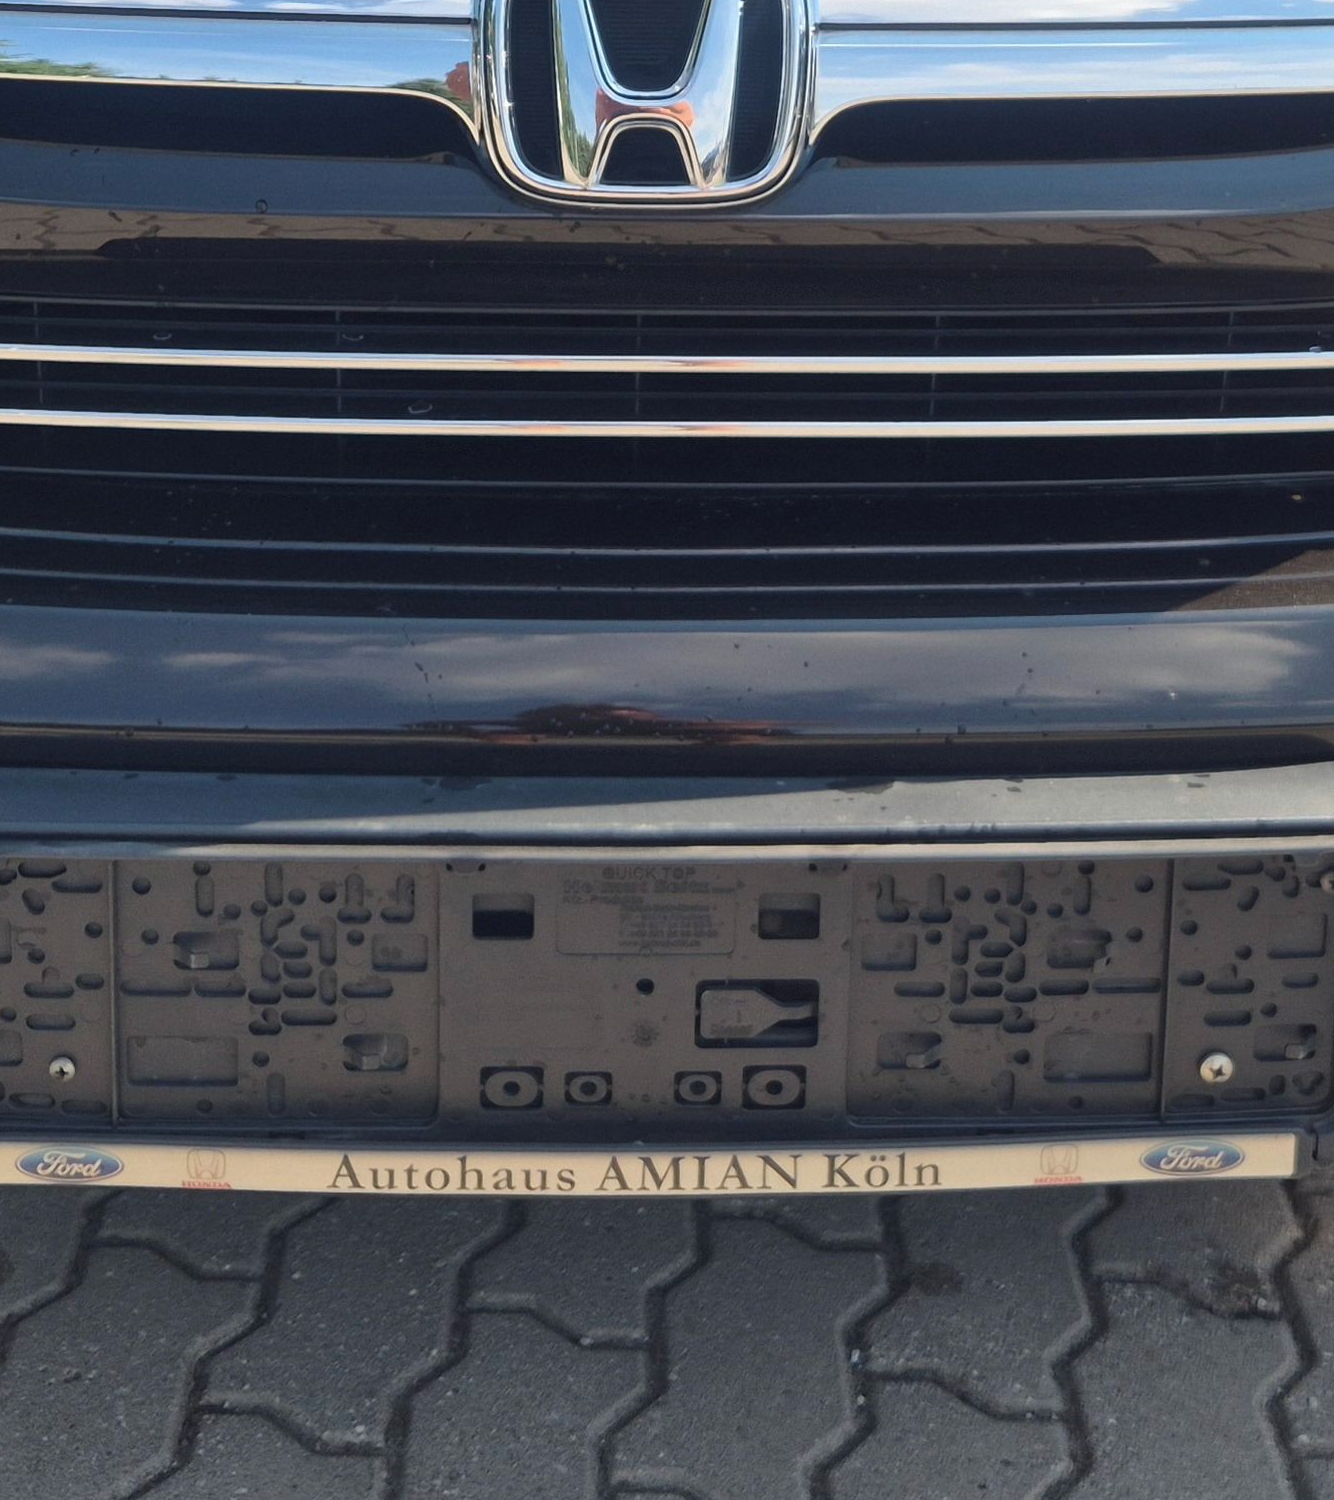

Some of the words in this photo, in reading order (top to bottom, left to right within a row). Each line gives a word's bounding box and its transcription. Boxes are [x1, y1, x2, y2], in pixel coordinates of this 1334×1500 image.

[662, 866, 696, 880] TOP
[37, 1150, 102, 1177] Ford
[1160, 1145, 1223, 1170] Ford
[327, 1153, 577, 1192] Autohaus
[595, 1153, 803, 1192] AMIAN
[822, 1152, 943, 1189] Köln
